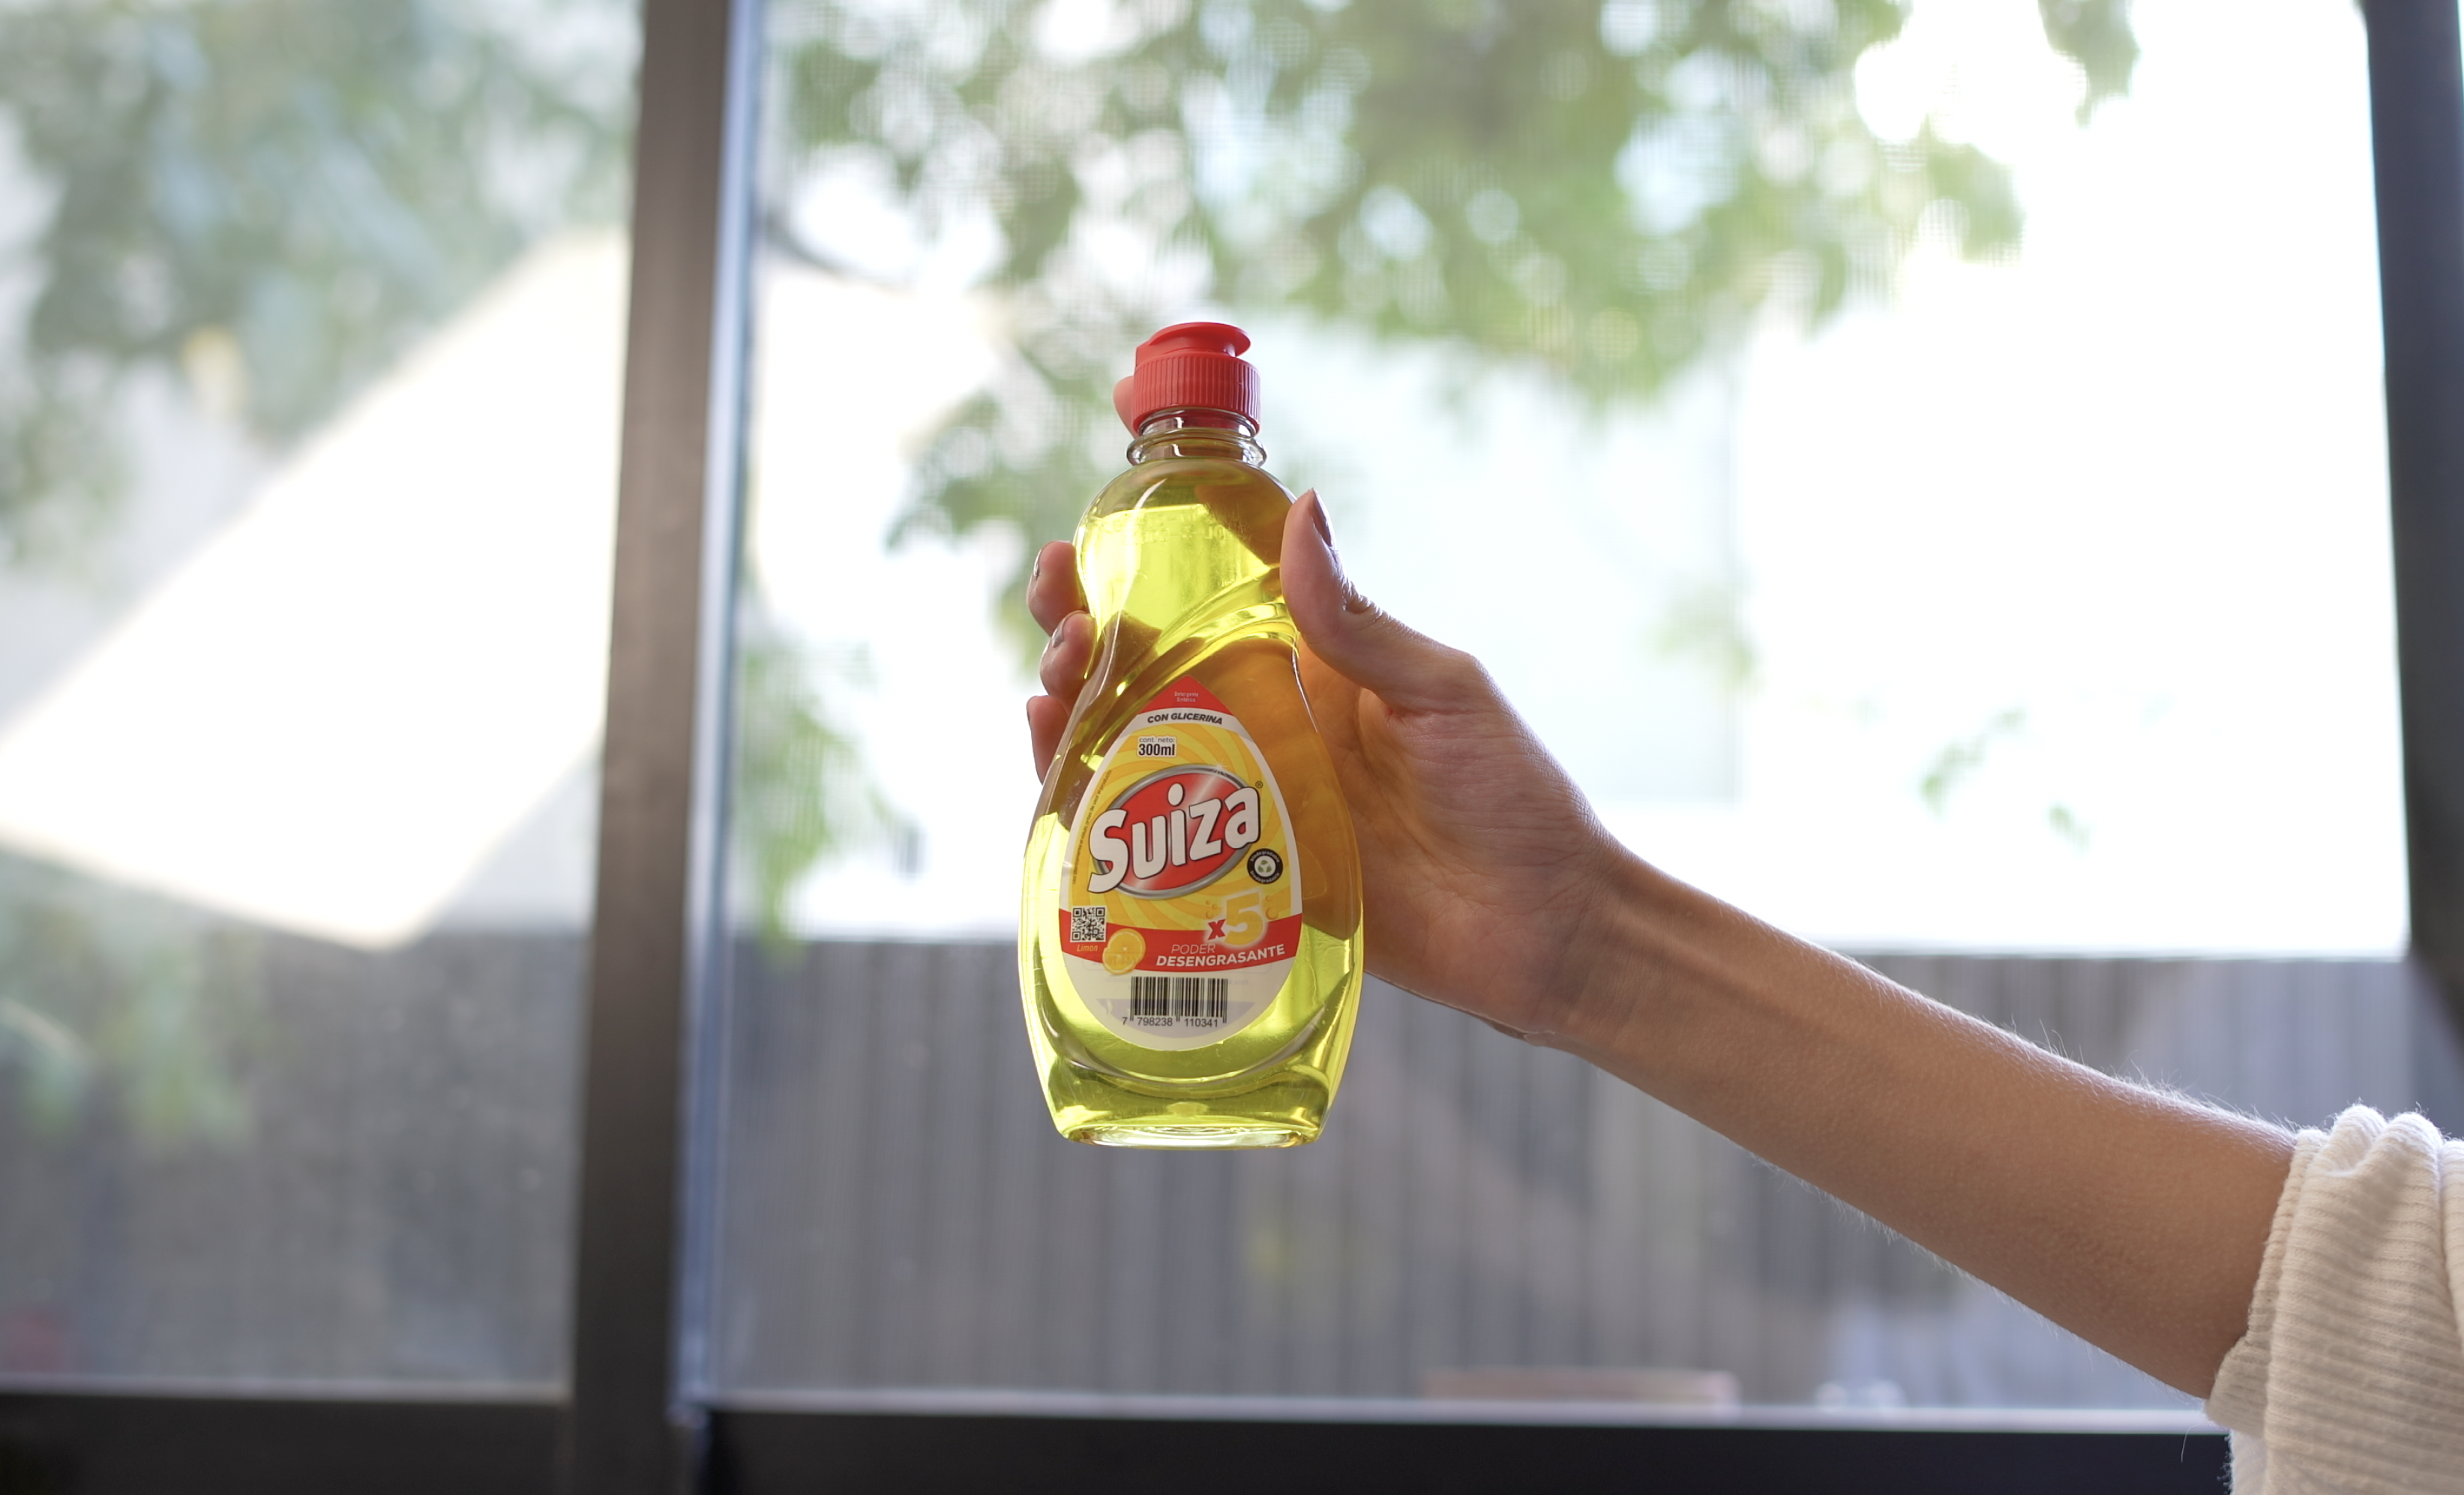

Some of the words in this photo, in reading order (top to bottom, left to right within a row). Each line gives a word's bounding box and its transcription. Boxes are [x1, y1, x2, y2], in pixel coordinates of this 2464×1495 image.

[1147, 713, 1169, 724] CON
[1171, 712, 1223, 725] GLICERINA
[1138, 743, 1175, 756] 300ml
[1087, 782, 1260, 894] Suiza
[1077, 944, 1099, 952] Limon
[1171, 944, 1216, 954] PODER
[1156, 943, 1285, 967] DESENGRASANTE
[1122, 1017, 1128, 1026] 7
[1137, 1017, 1173, 1026] 798238
[1184, 1018, 1218, 1027] 110341
